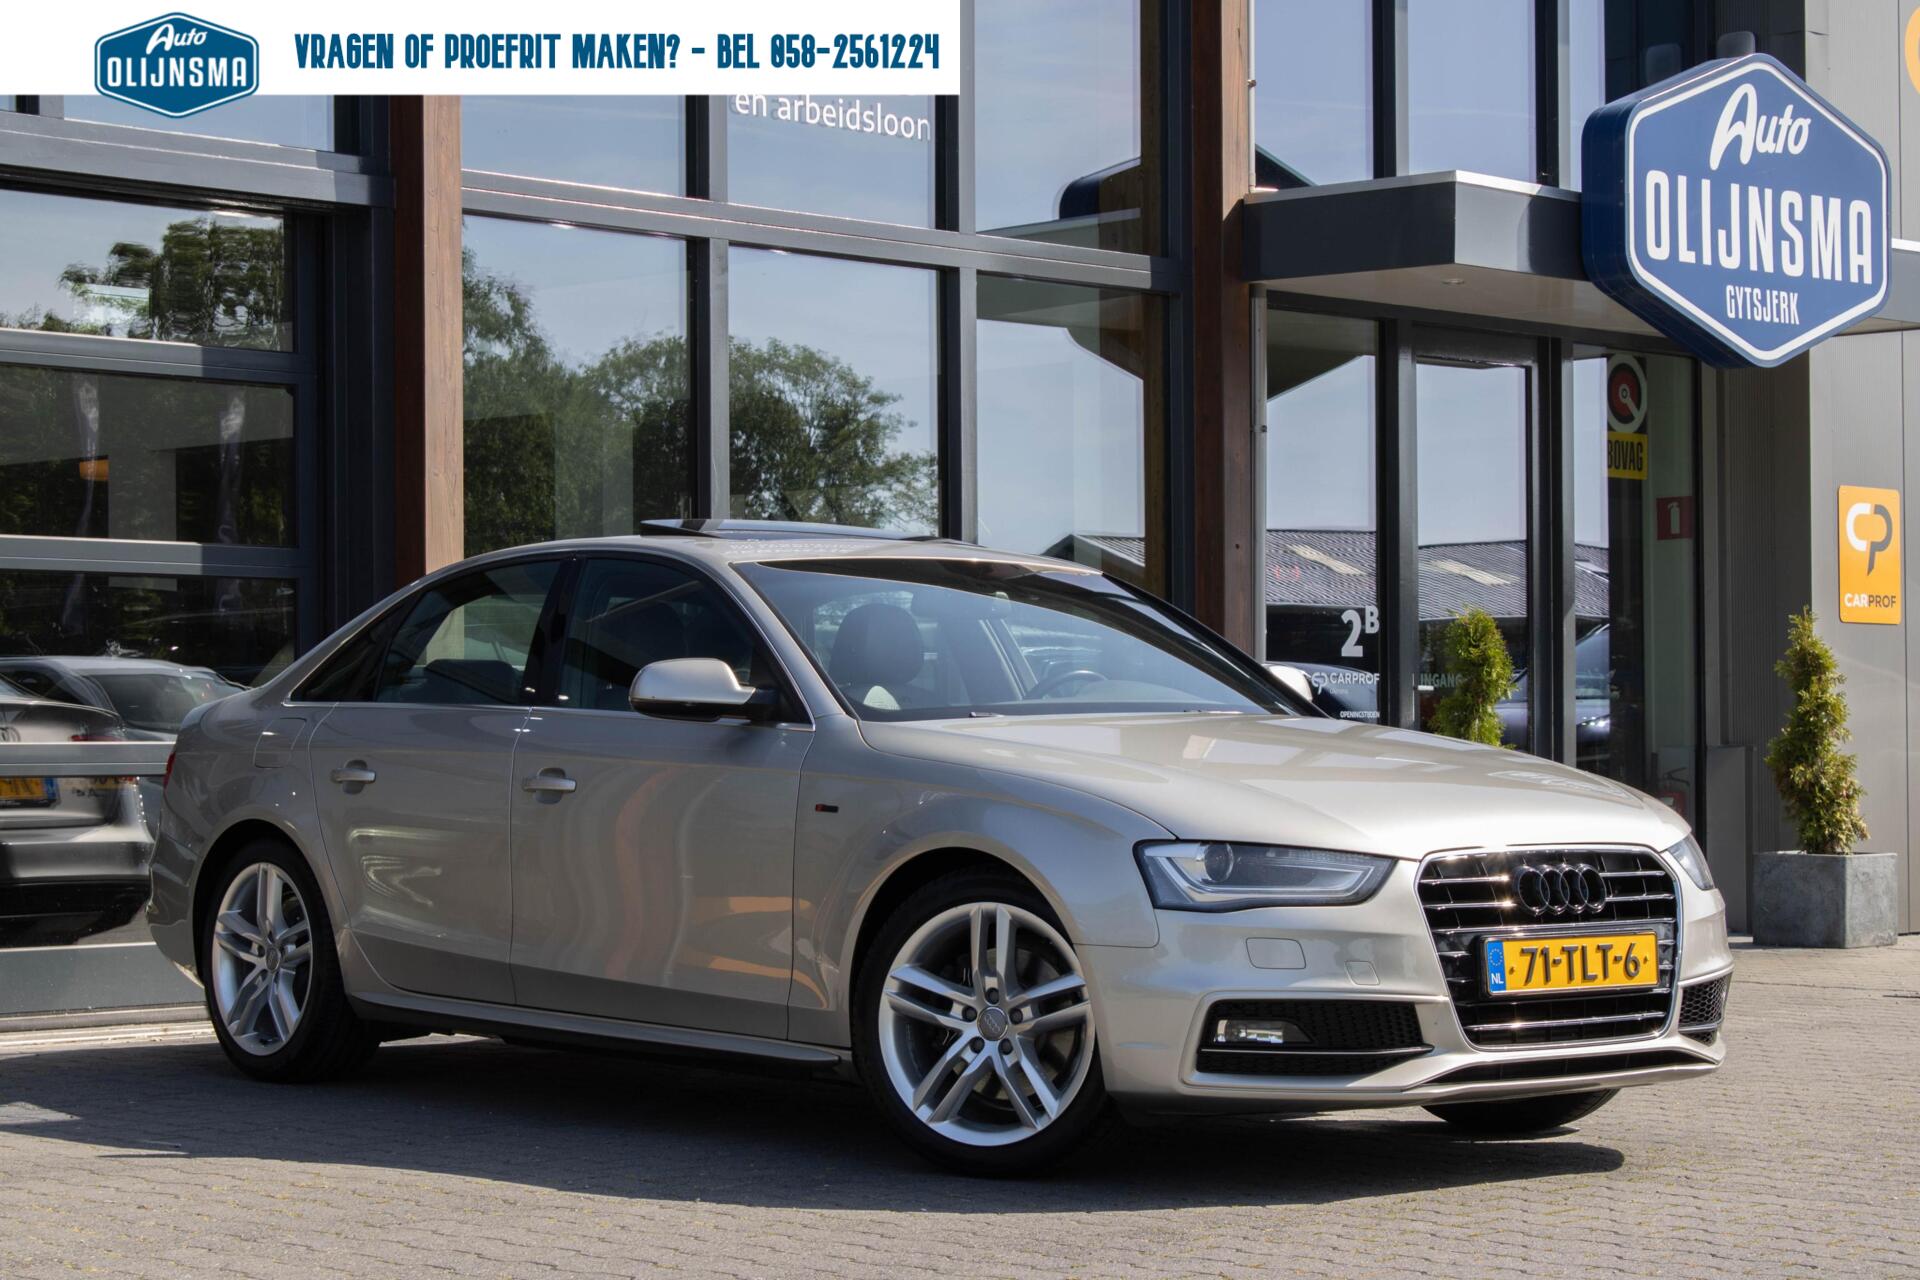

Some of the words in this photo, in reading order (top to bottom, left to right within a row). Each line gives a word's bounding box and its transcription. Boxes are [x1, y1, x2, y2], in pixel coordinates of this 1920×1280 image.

[735, 94, 767, 118] en
[777, 94, 930, 141] arbeidsloon
[1709, 83, 1811, 171] Auto
[1645, 169, 1872, 285] OLIJNSMA
[1725, 284, 1800, 325] GYTSJERK
[1608, 439, 1643, 472] BOVAG
[1844, 592, 1897, 609] CARPROF
[1329, 672, 1380, 685] CARPROF
[1490, 972, 1504, 985] NL
[1519, 942, 1641, 986] 71-TLT-6
